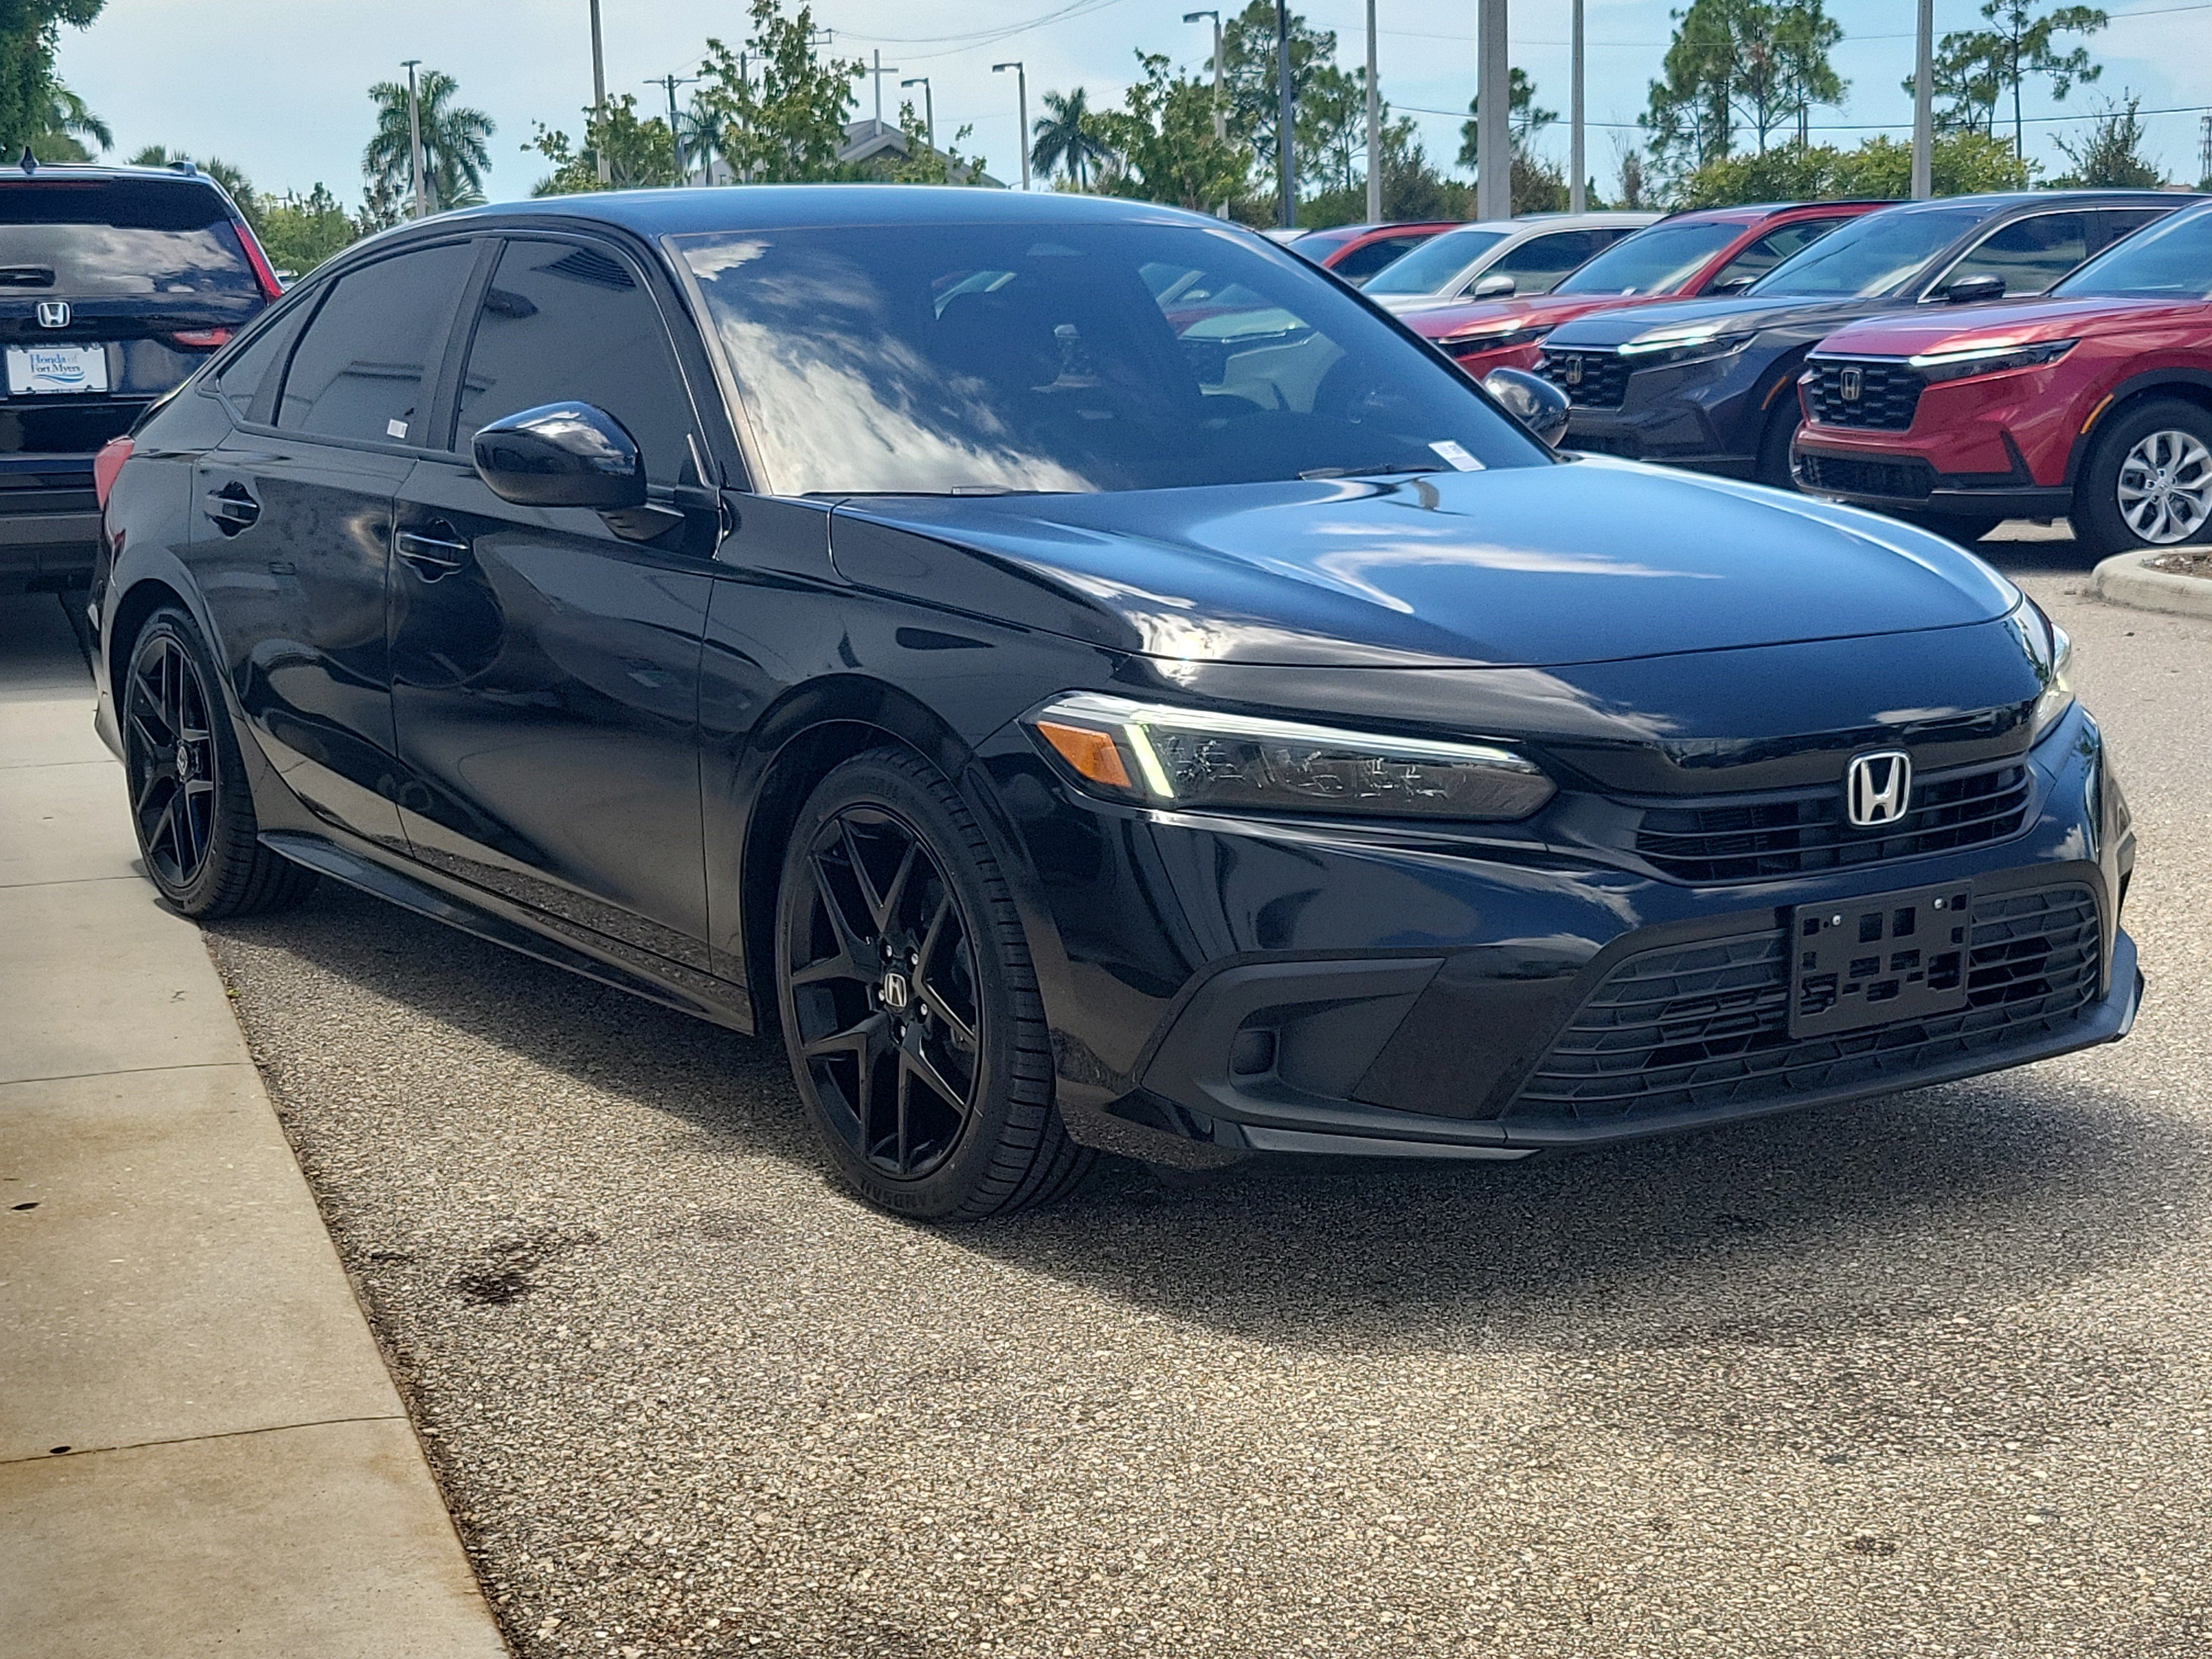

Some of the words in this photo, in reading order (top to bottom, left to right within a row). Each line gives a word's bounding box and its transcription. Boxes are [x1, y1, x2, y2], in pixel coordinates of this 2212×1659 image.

[30, 354, 65, 363] Honda
[31, 364, 50, 373] Fort
[52, 364, 80, 374] Myers
